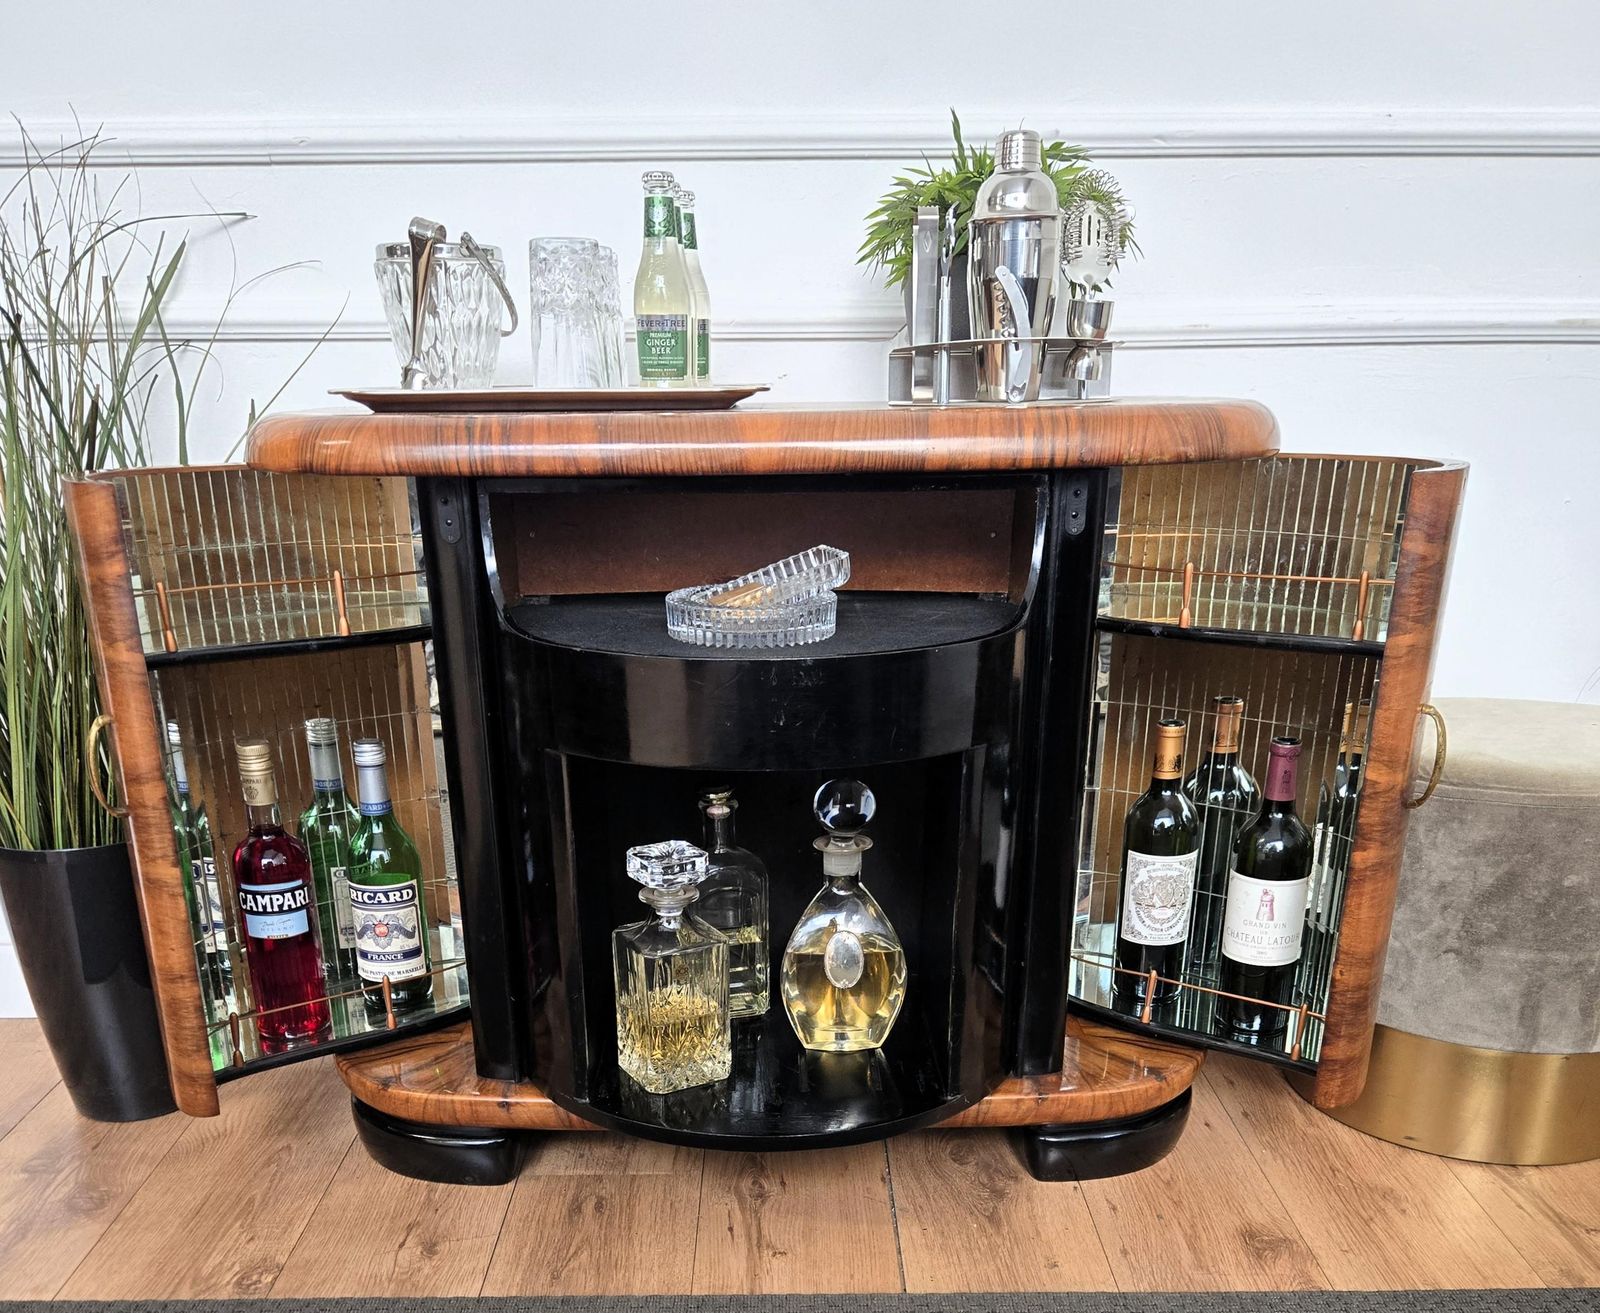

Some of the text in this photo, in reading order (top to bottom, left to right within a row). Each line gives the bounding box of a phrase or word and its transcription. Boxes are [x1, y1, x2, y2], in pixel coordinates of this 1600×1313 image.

[646, 338, 676, 346] GINGER
[239, 886, 309, 912] CAMPARI
[349, 888, 413, 904] RICARD
[1242, 919, 1270, 929] GRAND
[1226, 927, 1263, 945] CHATEAU
[367, 953, 403, 961] FRANCE
